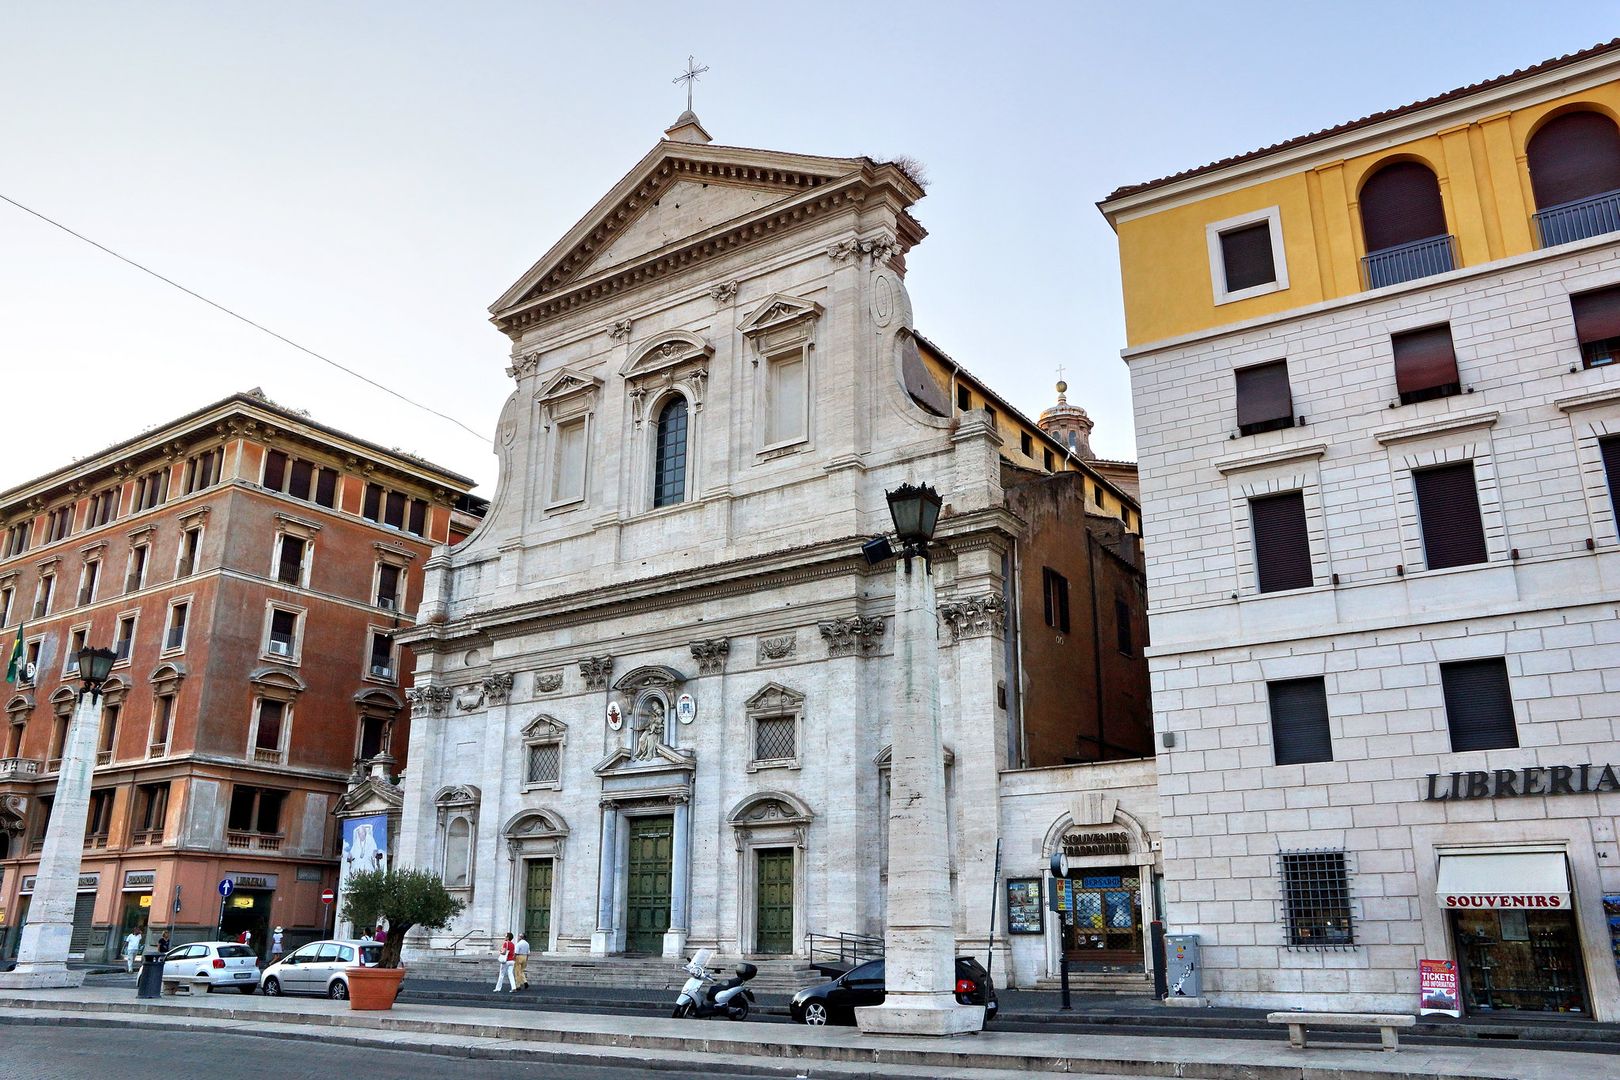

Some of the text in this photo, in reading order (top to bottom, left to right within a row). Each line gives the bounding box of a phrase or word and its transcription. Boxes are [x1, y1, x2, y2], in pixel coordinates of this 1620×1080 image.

[1425, 763, 1620, 800] LIBRERIA
[1062, 831, 1128, 846] SOUVENIRS
[1446, 895, 1561, 908] SOUVENIRS
[1421, 972, 1456, 982] TICKETS
